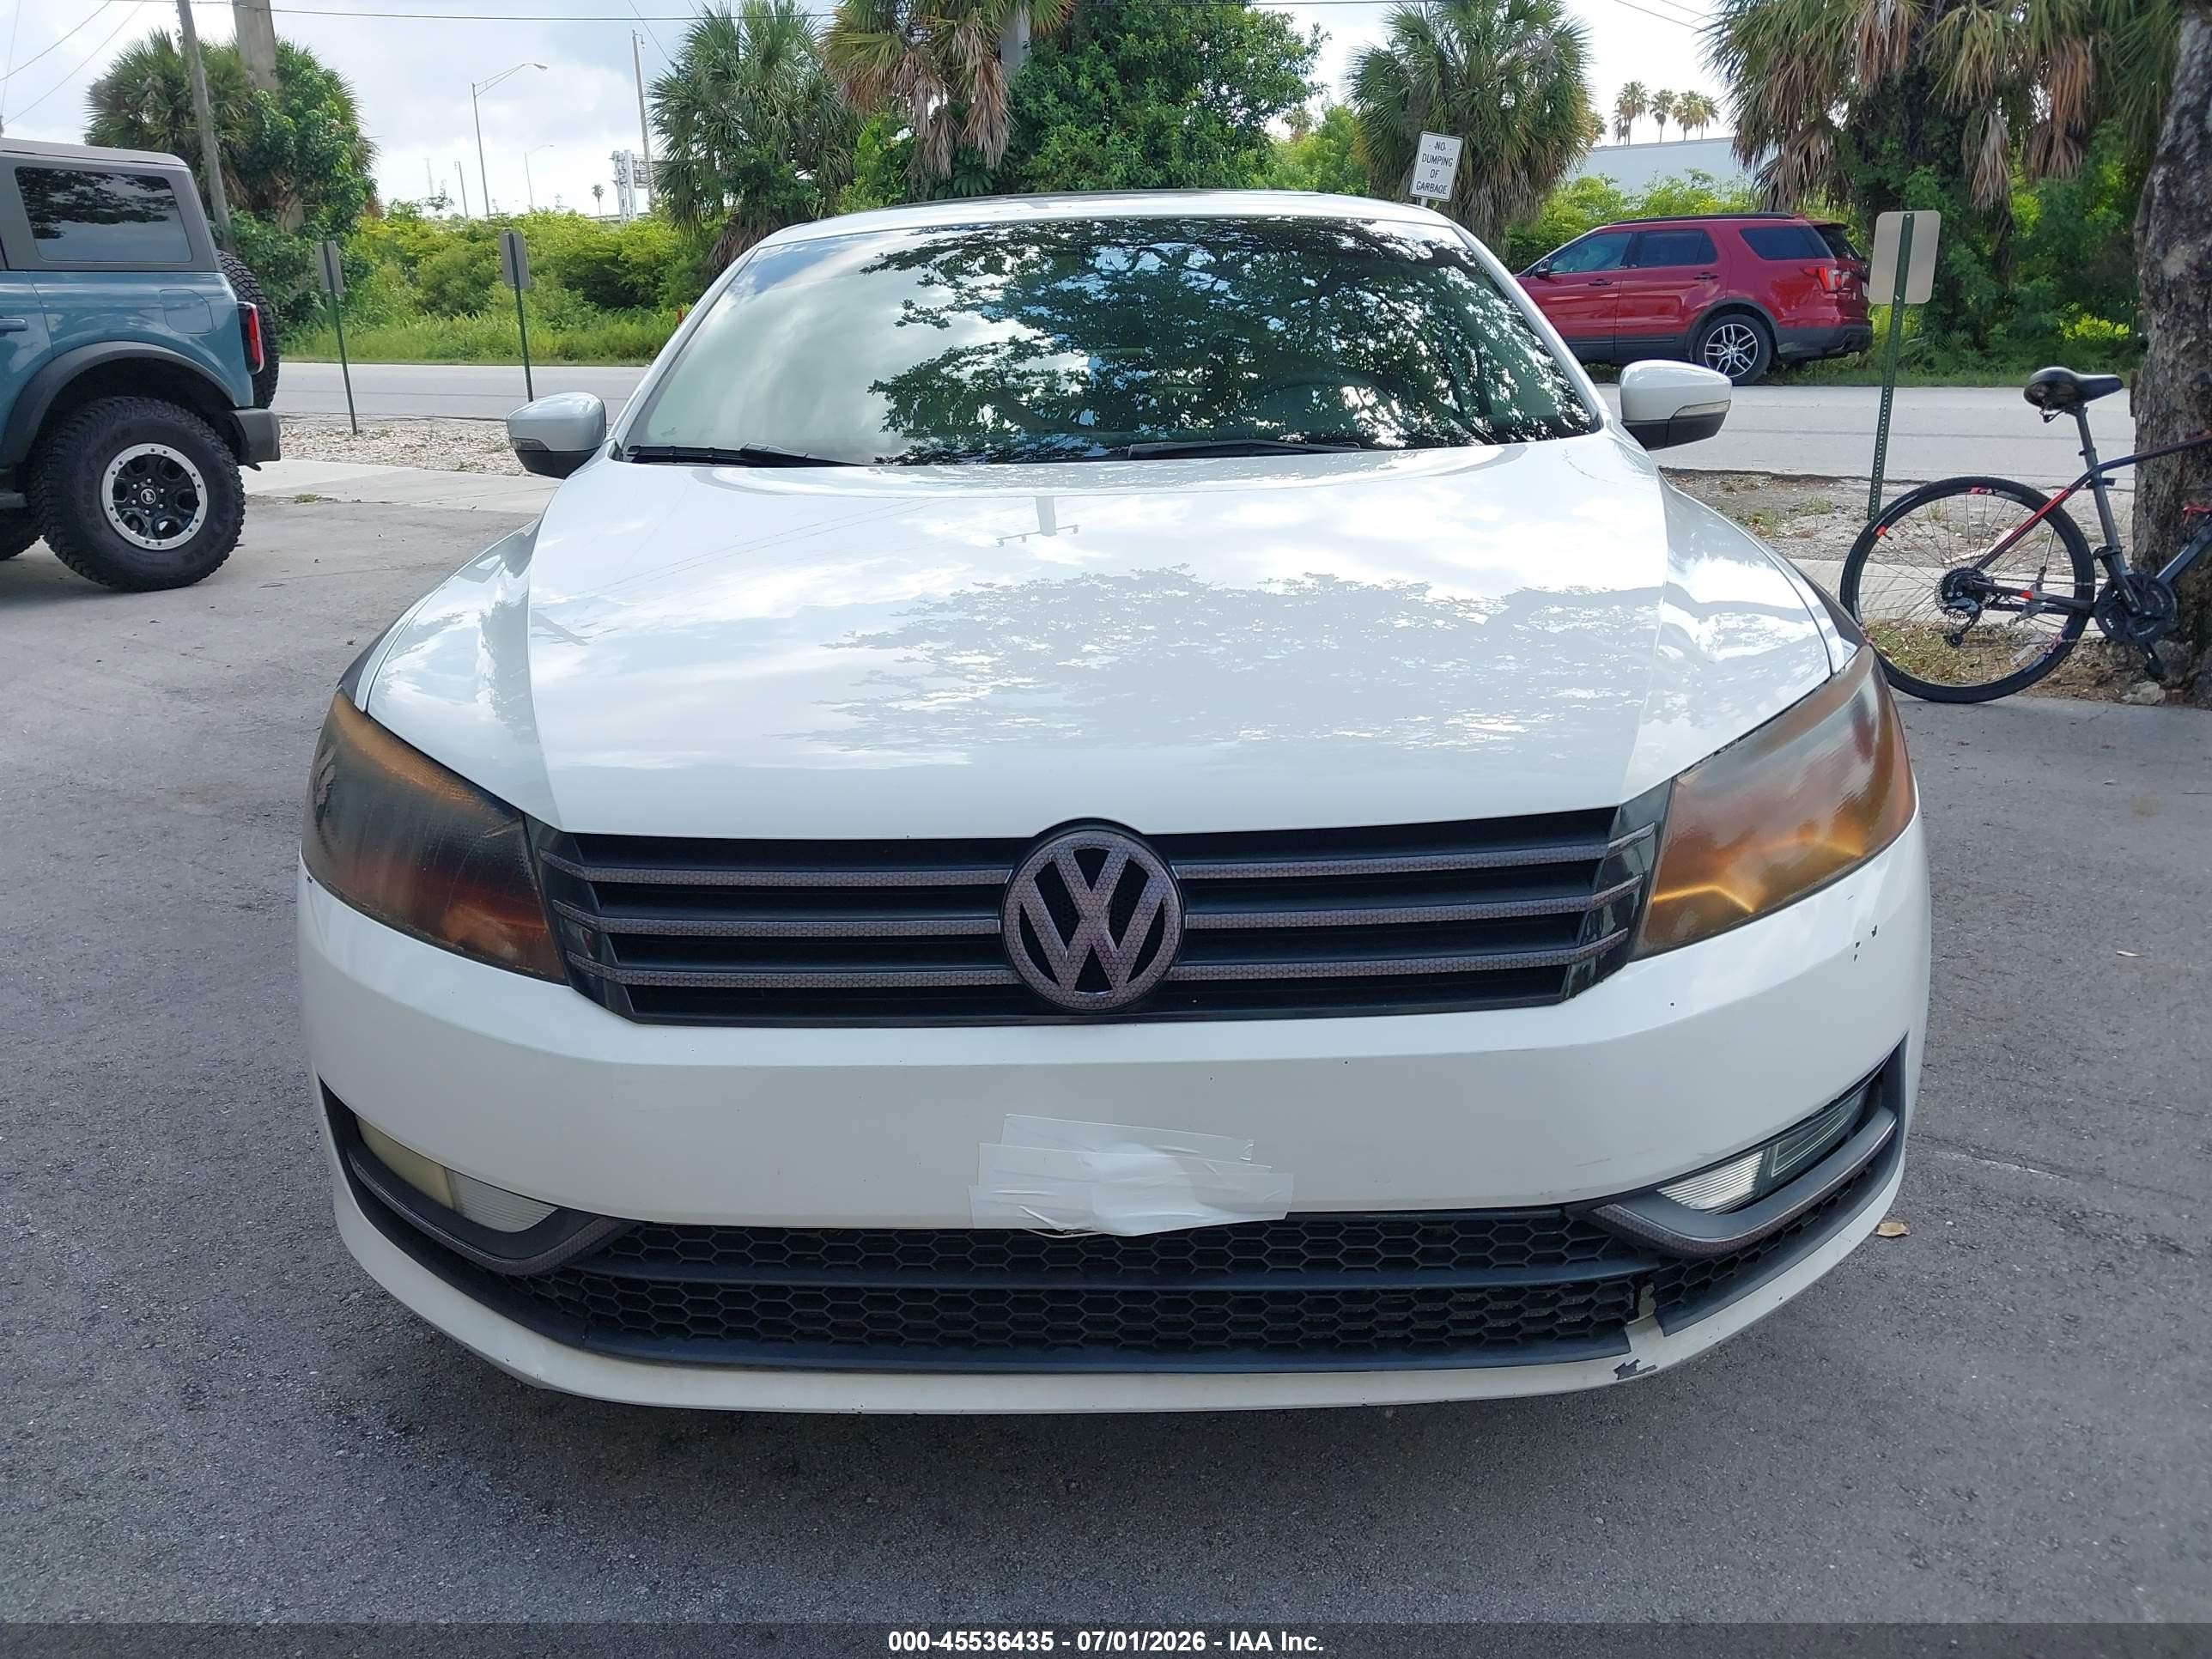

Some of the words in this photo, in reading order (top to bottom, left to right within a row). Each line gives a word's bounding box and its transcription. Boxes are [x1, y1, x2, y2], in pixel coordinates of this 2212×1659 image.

[1434, 141, 1446, 151] NO
[1422, 153, 1453, 167] DUMPING
[1430, 168, 1440, 179] OF
[1416, 180, 1448, 194] GARBAGE
[1018, 845, 1166, 994] VW
